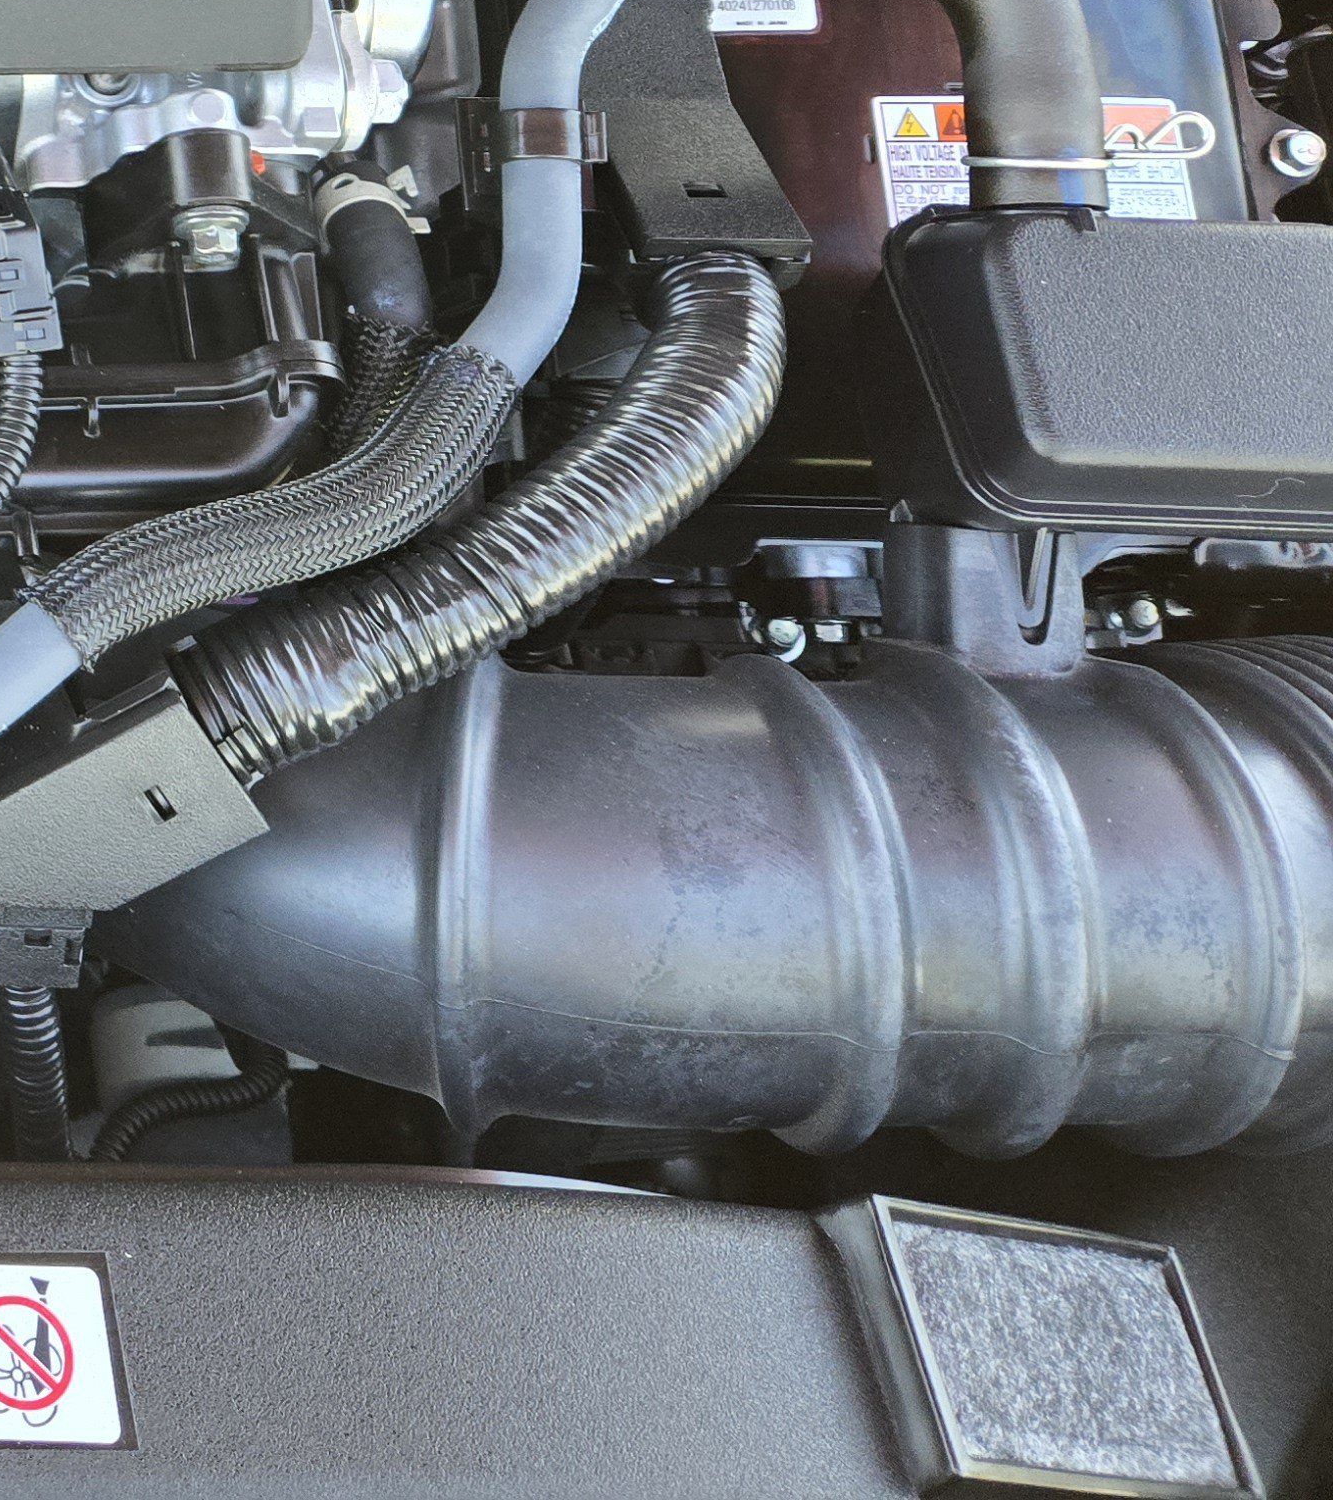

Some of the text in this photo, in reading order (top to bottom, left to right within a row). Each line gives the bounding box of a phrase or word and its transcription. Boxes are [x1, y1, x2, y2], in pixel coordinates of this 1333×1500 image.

[890, 145, 913, 161] HIGH
[915, 144, 957, 161] VOLTAGE
[892, 165, 922, 178] HAUTE
[923, 165, 962, 178] TENSION
[895, 184, 914, 195] DO
[921, 184, 947, 195] NOT
